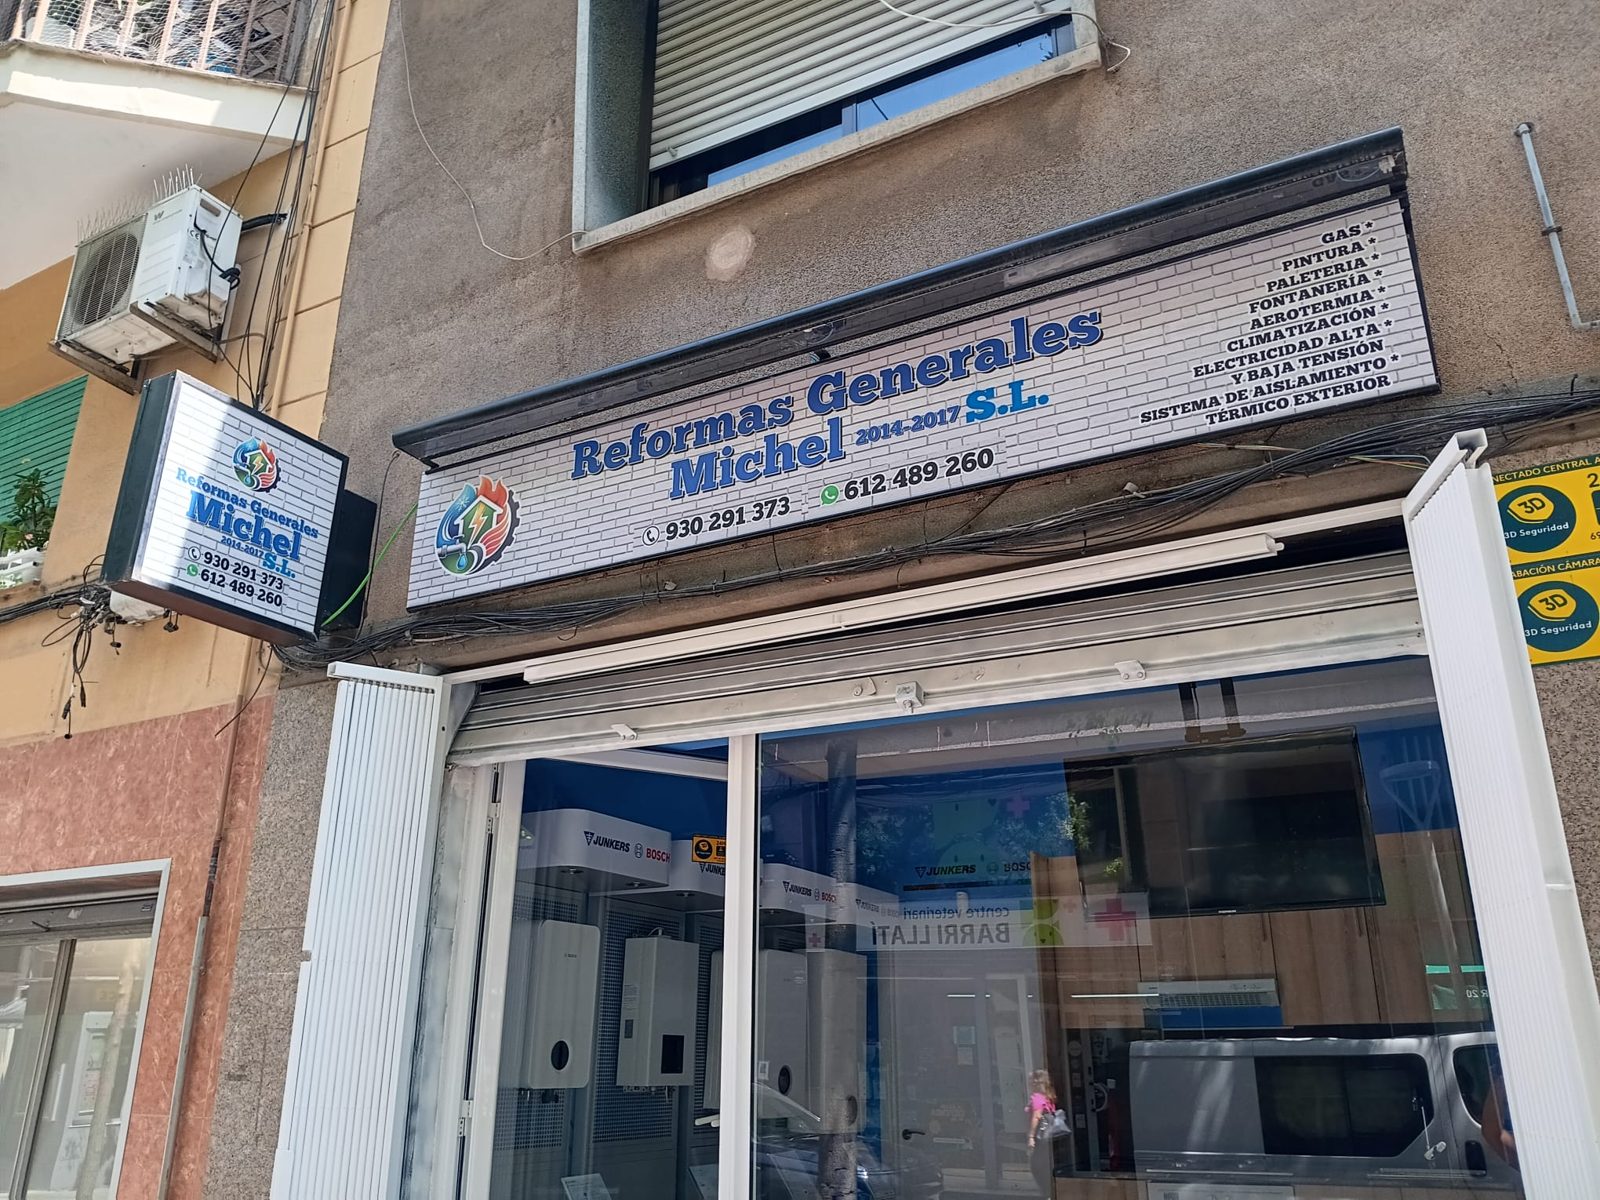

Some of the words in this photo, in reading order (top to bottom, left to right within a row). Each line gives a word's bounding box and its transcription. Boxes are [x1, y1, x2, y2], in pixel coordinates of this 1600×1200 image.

[1321, 225, 1361, 244] GAS
[1266, 257, 1368, 292] PALETERIA
[1282, 241, 1364, 271] PINTURA
[1249, 272, 1371, 313] FONTANERÍA
[1250, 290, 1374, 330] AEROTERMIA
[1227, 304, 1376, 352] CLIMATIZACIÓN
[1193, 337, 1323, 377] ELECTRICIDAD
[1328, 324, 1380, 345] ALTA
[1231, 373, 1245, 385] Y
[1248, 362, 1295, 383] BAJA
[1299, 340, 1384, 369] TENSIÓN
[571, 395, 795, 480] Reformas
[807, 311, 1104, 415] Generales
[1140, 395, 1221, 423] SISTEMA
[1226, 388, 1248, 405] DE
[1253, 357, 1386, 398] AISLAMIENTO
[1206, 396, 1289, 425] TÉRMICO
[1294, 375, 1391, 406] EXTERIOR
[669, 416, 847, 501] Michel
[855, 405, 961, 446] 2014-2017
[966, 379, 1050, 424] S.L.
[844, 473, 886, 500] 612
[892, 461, 938, 488] 489
[945, 448, 994, 475] 260
[1492, 467, 1541, 482] NECTADO
[1543, 458, 1592, 473] CENTRAL
[1587, 473, 1600, 488] 2
[176, 467, 248, 512] Reformas
[250, 498, 319, 540] Generales
[665, 516, 703, 541] 930
[708, 506, 745, 532] 291
[752, 496, 790, 522] 373
[1517, 497, 1546, 514] 3D
[186, 490, 302, 562] Michel
[1504, 530, 1517, 540] 3D
[1519, 521, 1570, 538] Seguridad
[1590, 531, 1600, 541] 69
[203, 551, 230, 571] 930
[233, 562, 257, 582] 291
[260, 572, 284, 590] 373
[220, 535, 264, 559] 2014-2017
[262, 552, 296, 578] S.L.
[1511, 564, 1555, 578] ABACIÓN
[1558, 557, 1600, 571] CÁMARA
[200, 568, 226, 587] 612
[229, 578, 254, 597] 489
[257, 589, 283, 607] 260
[1538, 593, 1568, 611] 3D
[1525, 628, 1538, 637] 3D
[1541, 620, 1592, 635] Seguridad
[593, 835, 631, 853] JUNKERS
[646, 847, 671, 864] BOSCH
[926, 864, 976, 876] JUNKERS
[1004, 861, 1031, 872] BOSC
[705, 864, 726, 876] JUNKE
